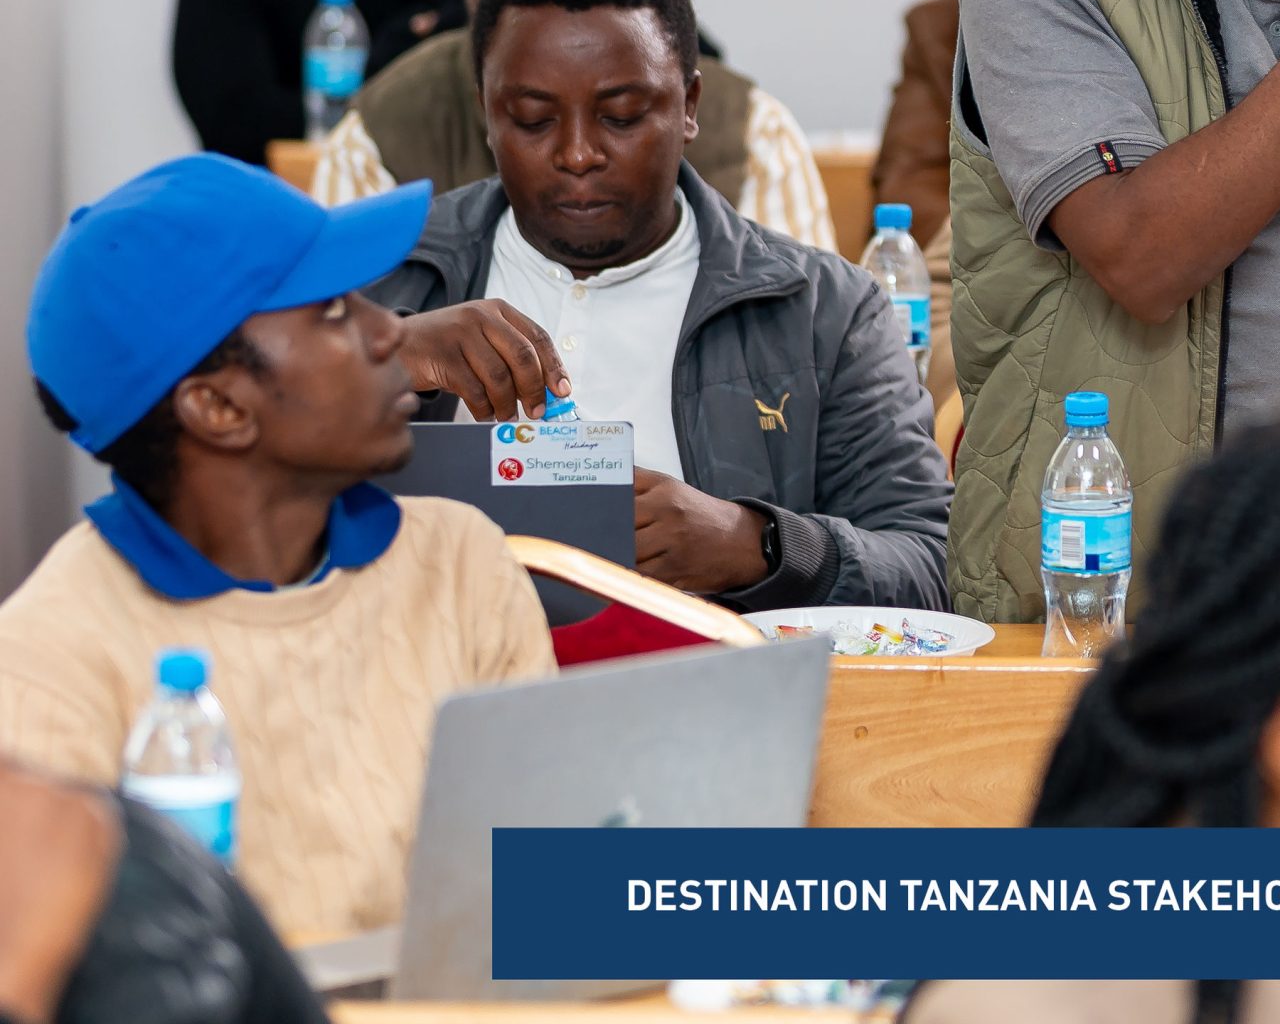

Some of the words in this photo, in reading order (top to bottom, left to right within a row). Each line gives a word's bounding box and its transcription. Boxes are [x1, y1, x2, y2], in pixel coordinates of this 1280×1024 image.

[540, 426, 577, 435] BEACH
[586, 426, 624, 435] SAFARI
[526, 457, 581, 473] Shemeji
[584, 457, 623, 470] Safari
[553, 473, 597, 482] Tanzania
